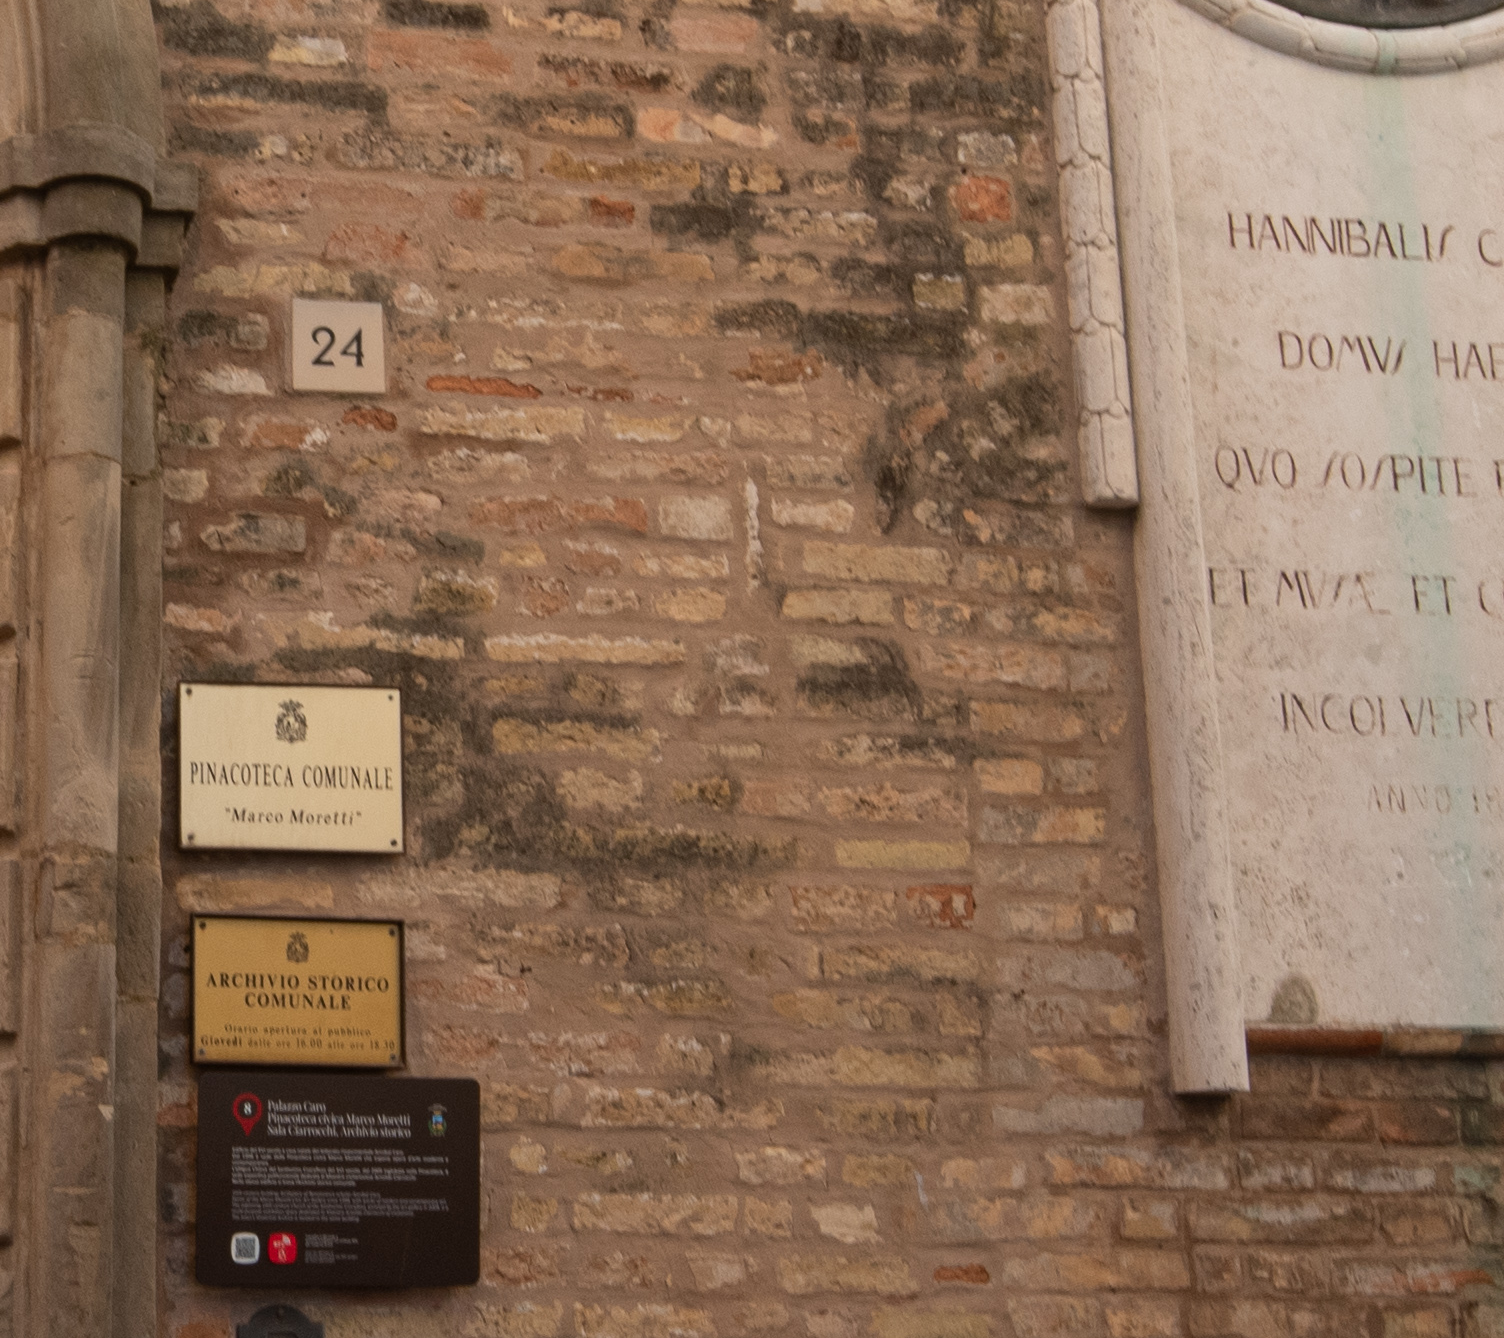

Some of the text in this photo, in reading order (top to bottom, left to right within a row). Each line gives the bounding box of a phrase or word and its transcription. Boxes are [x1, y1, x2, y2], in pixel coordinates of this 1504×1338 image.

[1226, 212, 1456, 263] HANNIBALIS
[310, 325, 365, 368] 24
[1214, 445, 1297, 492] QVO
[1207, 567, 1253, 607] ET
[1410, 573, 1457, 617] ET
[189, 761, 394, 791] PINACOTECA COMUNALE
[225, 807, 362, 826] "Marco Moretti"
[206, 972, 390, 993] ARCHIVIO STORICO
[245, 992, 352, 1011] COMUNALE
[224, 1023, 258, 1035] Orario
[263, 1025, 307, 1037] apertura
[327, 1027, 371, 1039] pubblico
[243, 1102, 252, 1115] 8
[303, 1100, 326, 1113] Caro
[267, 1111, 410, 1128] Pinacoteca civica Marco Moretti
[267, 1124, 286, 1137] Sala
[341, 1125, 379, 1138] Archivio
[380, 1126, 411, 1139] storico
